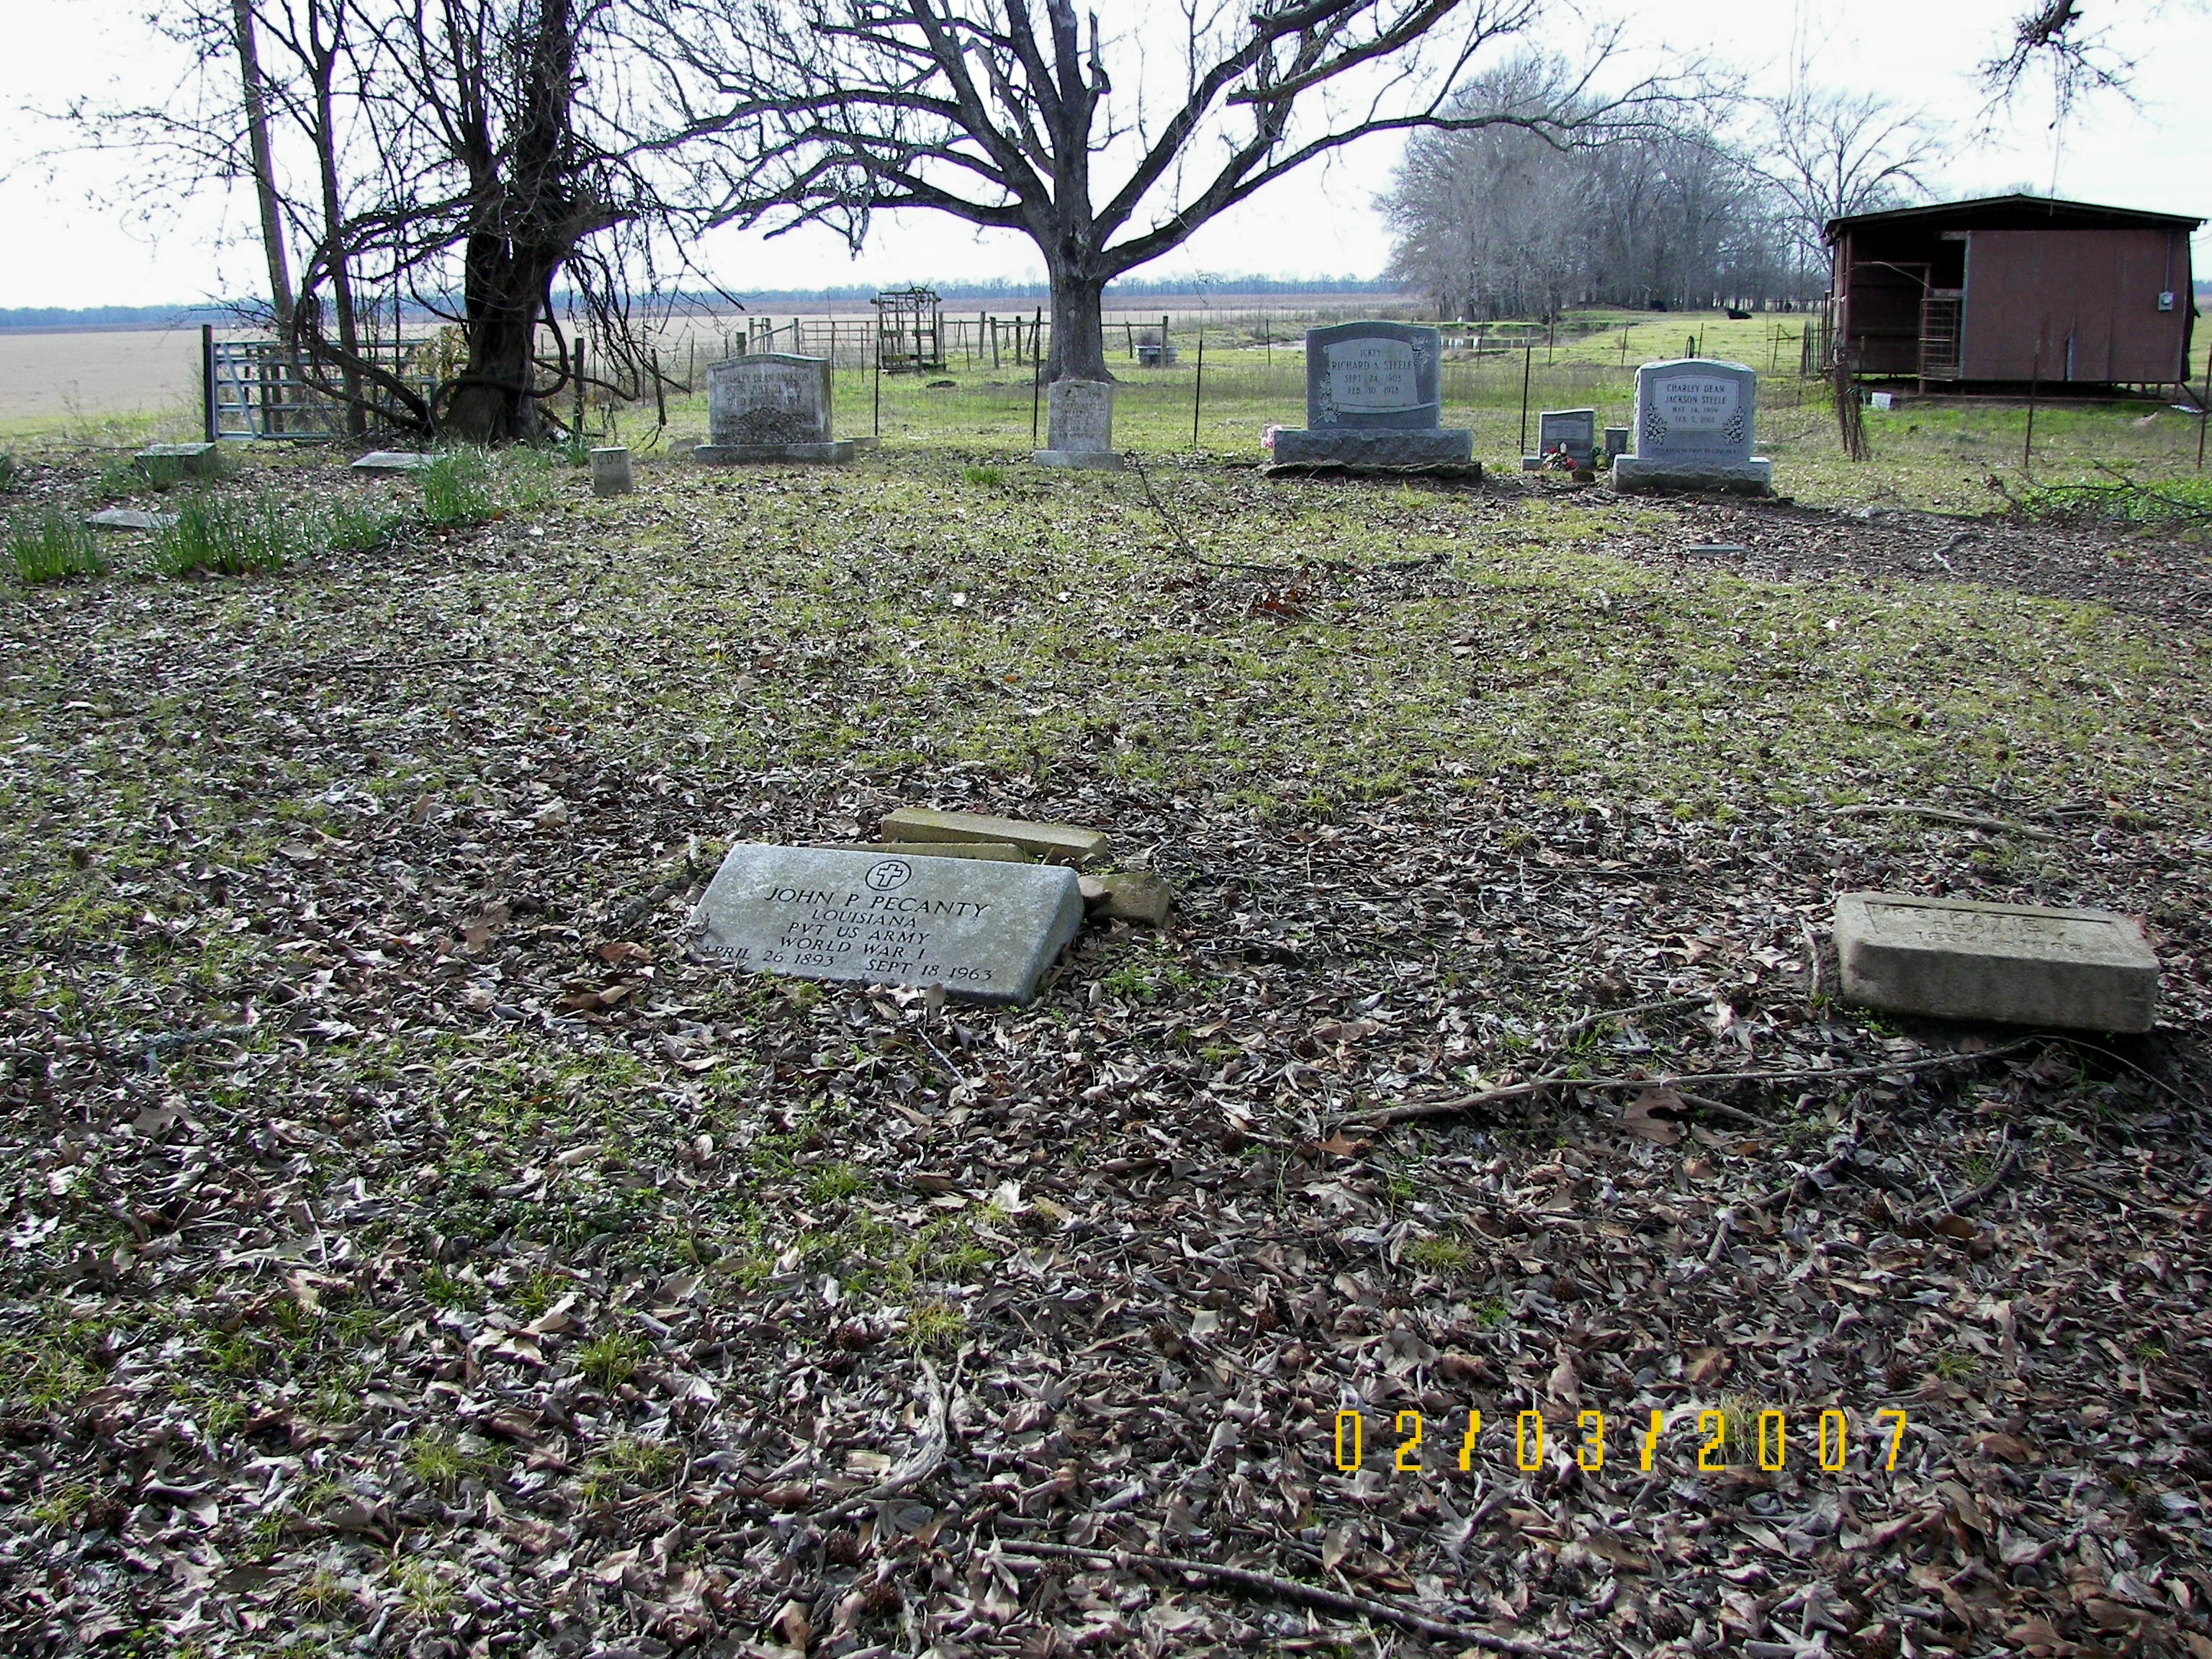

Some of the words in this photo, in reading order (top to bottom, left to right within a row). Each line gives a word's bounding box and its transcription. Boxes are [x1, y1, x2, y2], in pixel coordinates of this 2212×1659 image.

[1332, 361, 1370, 371] RICHARD
[1384, 361, 1411, 370] STEELE
[718, 374, 750, 384] CHARLEY
[1667, 384, 1699, 392] CHARLEY
[1704, 385, 1725, 393] DEAN
[764, 887, 835, 906] JOHN
[845, 894, 860, 907] P
[871, 896, 989, 918] PECANTY
[811, 909, 917, 929] LOUISIANA
[787, 922, 827, 936] PVT
[837, 926, 860, 939] US
[868, 930, 930, 945] ARMY
[780, 936, 852, 953] WORLD
[863, 943, 904, 959] WAR
[918, 948, 927, 961] I
[703, 945, 750, 959] APRIL
[762, 950, 784, 963] 26
[794, 953, 835, 967] 1893
[866, 959, 913, 975] SEPT
[921, 964, 940, 977] 18
[949, 966, 993, 981] 1963
